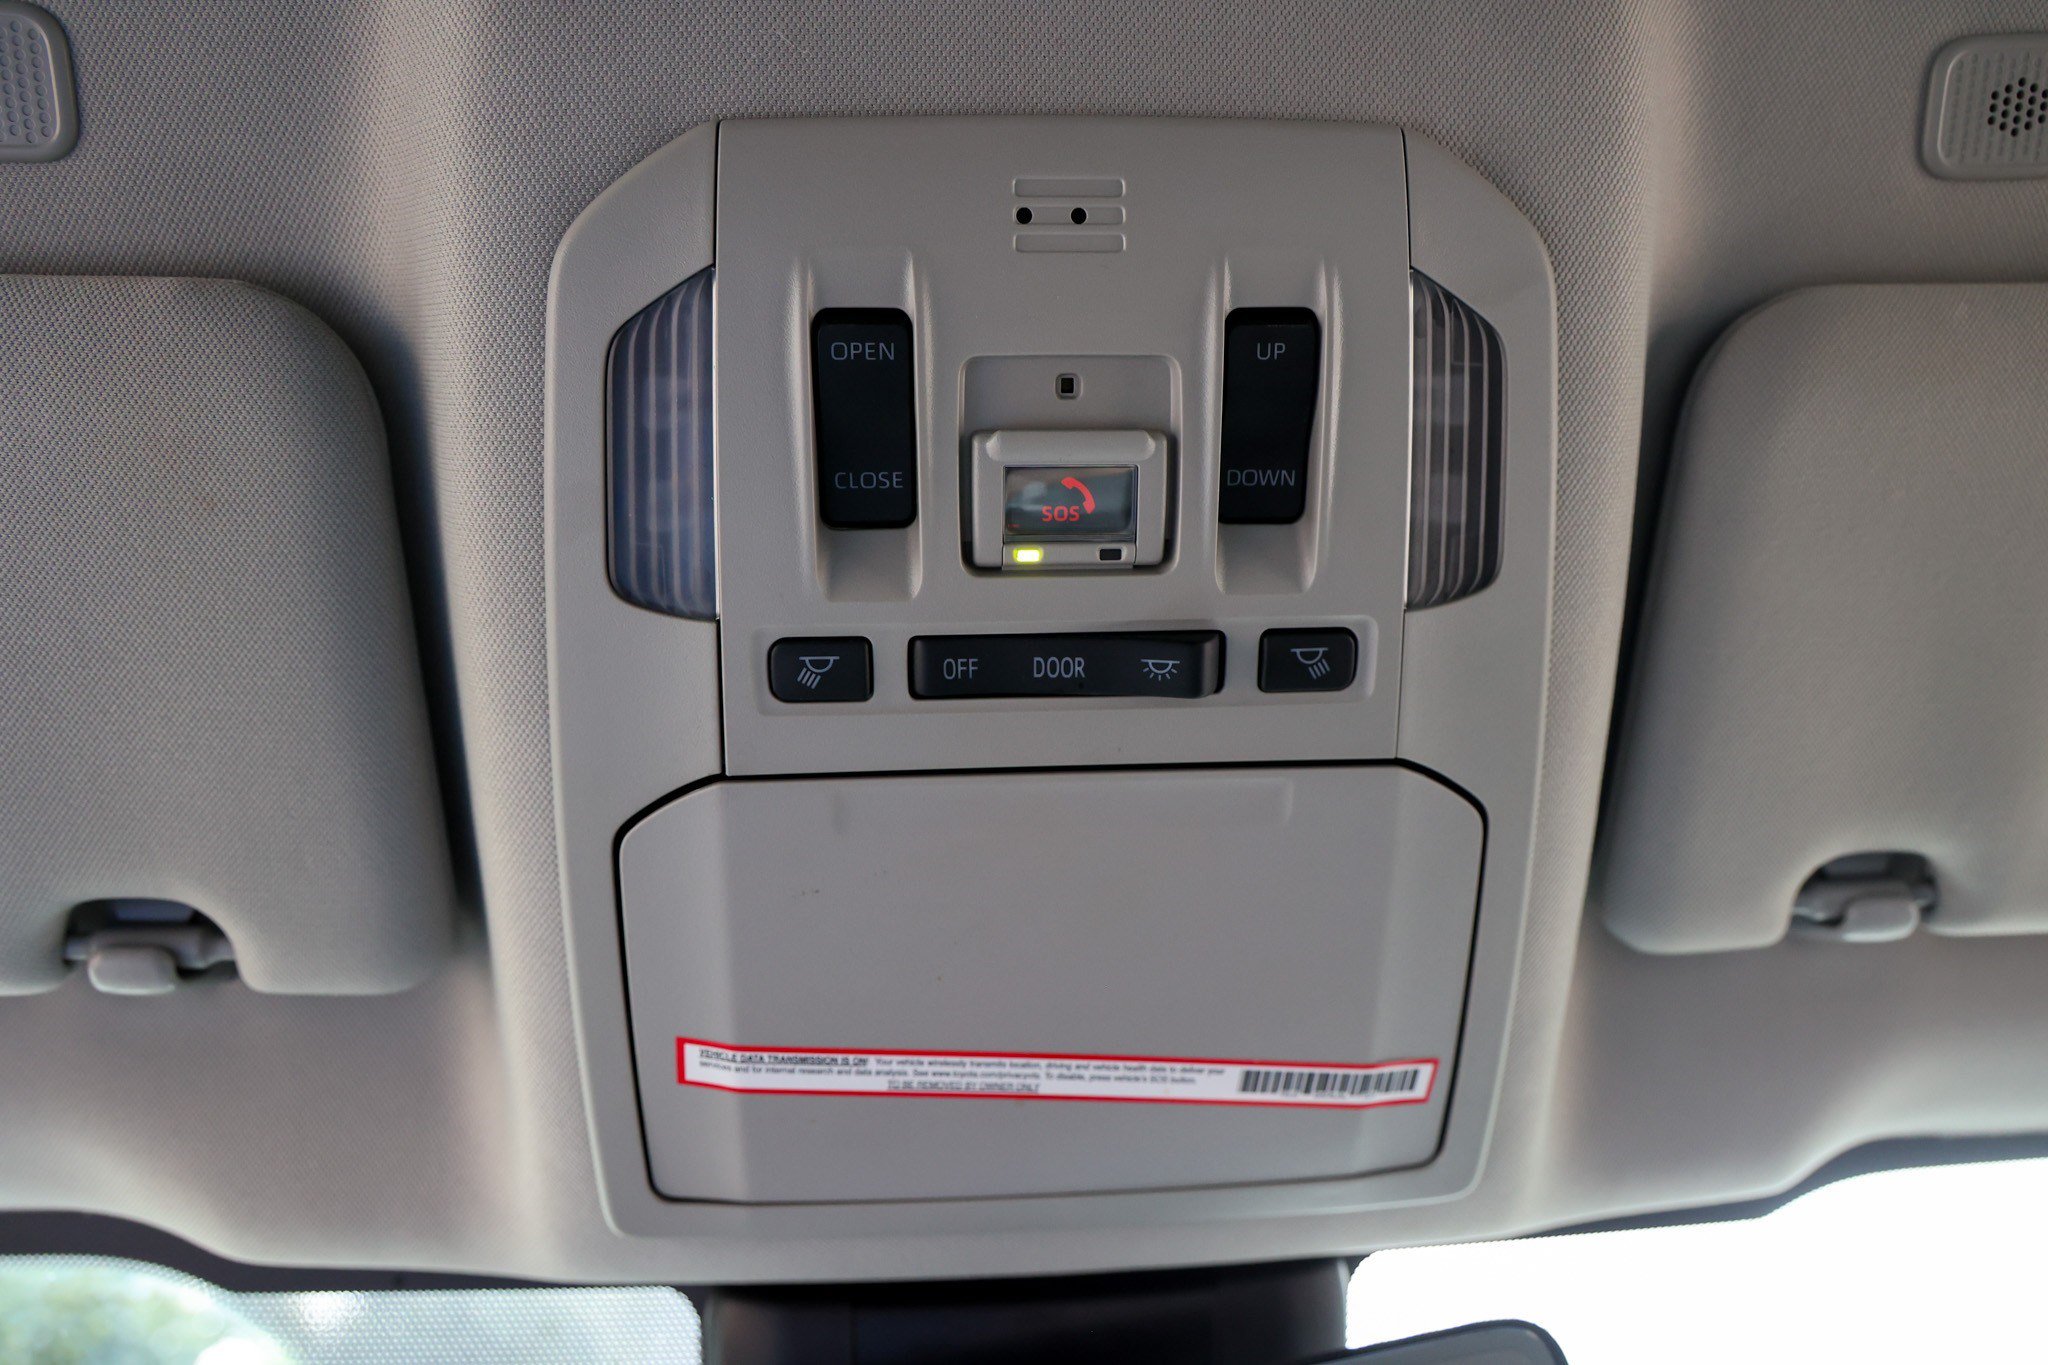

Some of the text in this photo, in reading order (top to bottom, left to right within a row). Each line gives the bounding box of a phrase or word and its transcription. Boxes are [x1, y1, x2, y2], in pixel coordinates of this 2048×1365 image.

[830, 341, 895, 361] OPEN
[1256, 342, 1286, 361] UP
[834, 471, 904, 489] CLOSE
[1227, 469, 1296, 487] DOWN
[1041, 505, 1080, 522] SOS
[943, 657, 1085, 680] OFF DOOR
[699, 1049, 738, 1062] VEHICLE
[740, 1053, 764, 1064] DATA
[767, 1055, 838, 1066] TRANSMISSION
[840, 1057, 850, 1067] IS
